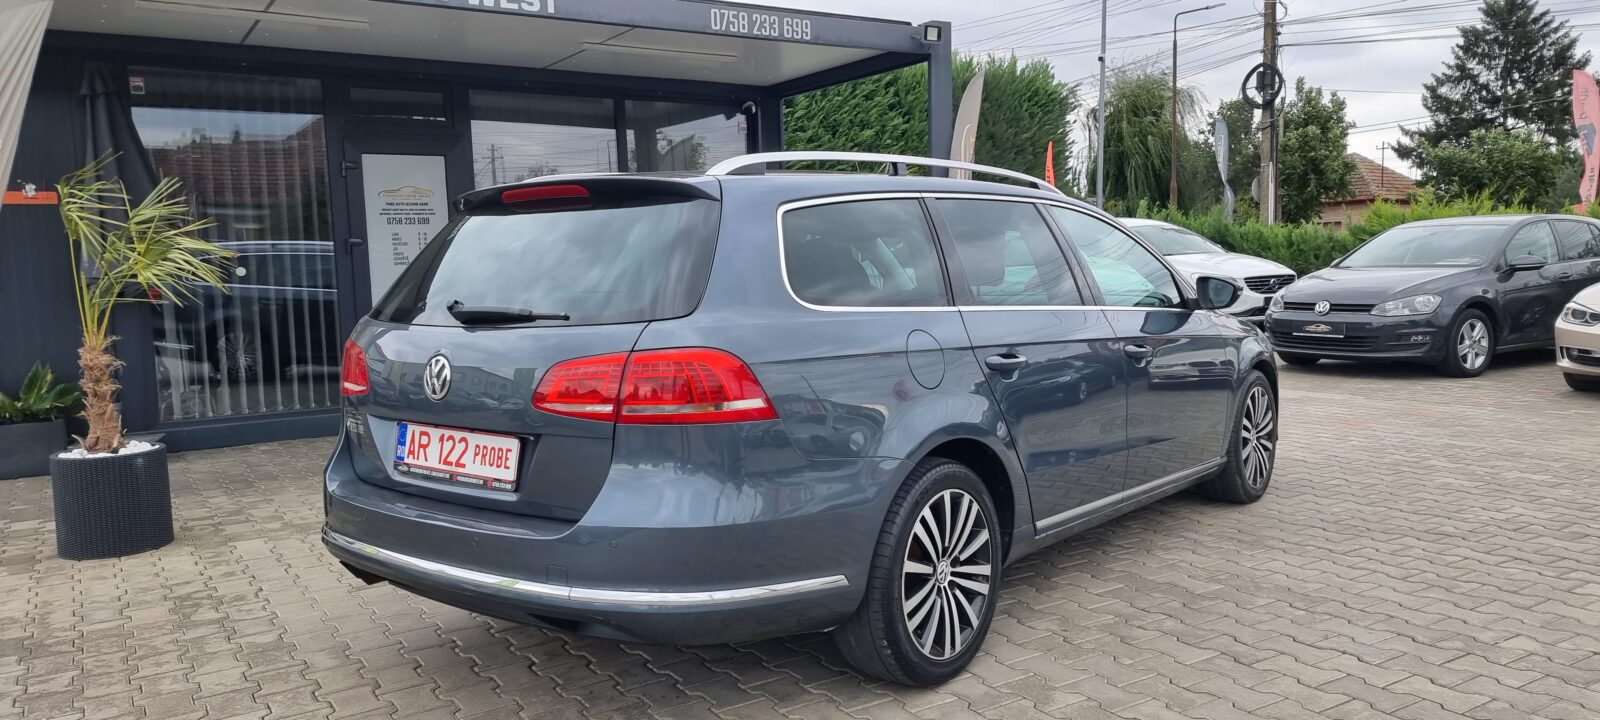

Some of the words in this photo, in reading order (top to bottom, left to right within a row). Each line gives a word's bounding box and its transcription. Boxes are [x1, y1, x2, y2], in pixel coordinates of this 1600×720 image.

[710, 8, 748, 33] 0758
[752, 13, 779, 36] 233
[783, 17, 811, 40] 699
[386, 217, 403, 225] 0758
[404, 217, 416, 225] 233
[417, 217, 430, 225] 699
[406, 429, 431, 462] AR
[438, 433, 469, 469] 122
[472, 443, 513, 470] PROBE
